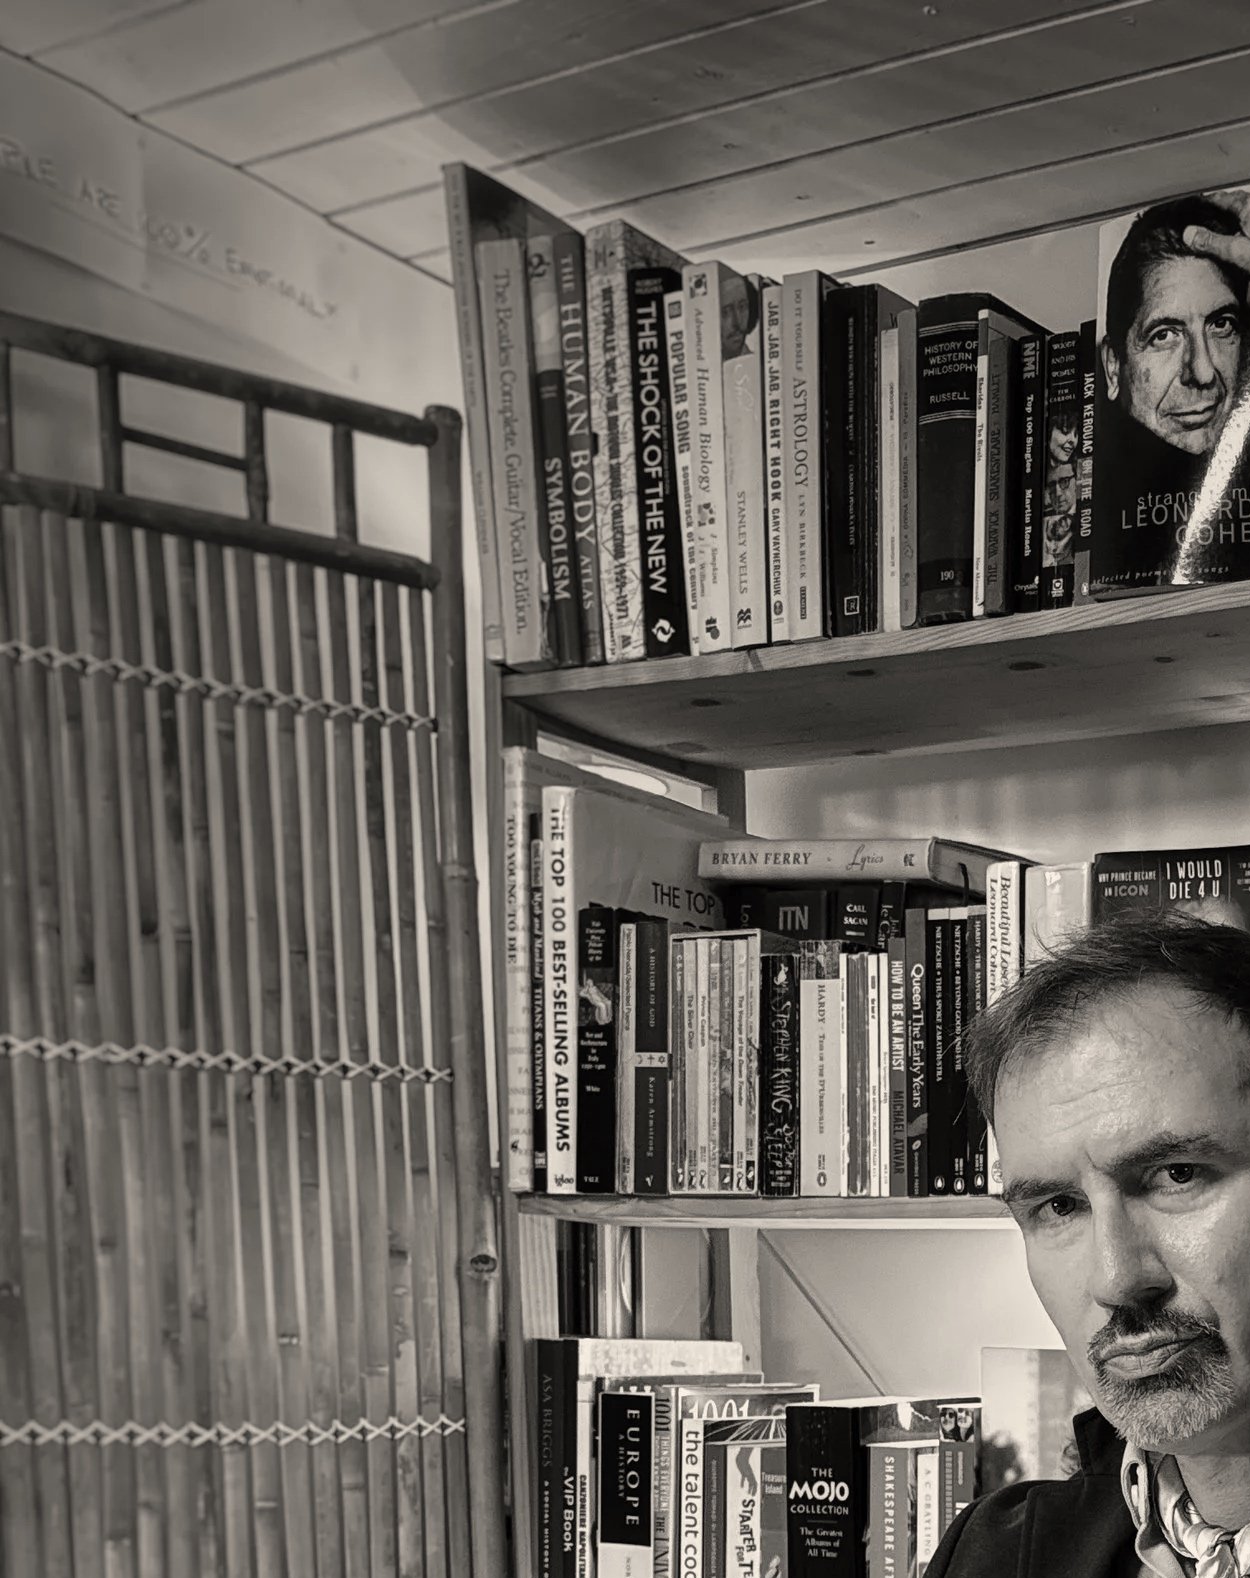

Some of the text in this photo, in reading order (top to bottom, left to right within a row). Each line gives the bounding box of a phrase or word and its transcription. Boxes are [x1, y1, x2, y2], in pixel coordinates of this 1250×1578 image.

[492, 269, 513, 305] The
[495, 306, 517, 367] Beatles
[924, 340, 979, 355] HISTORY OF
[922, 363, 979, 377] PHILOSOPHY
[928, 352, 972, 365] WESTERN
[1021, 342, 1036, 380] NME
[669, 331, 691, 455] POPULAR SONG
[930, 391, 970, 405] RUSSELL
[1083, 372, 1096, 398] JACK
[559, 254, 596, 609] THE HUMAN BODY ATLAS
[636, 301, 668, 594] THE SHOCK OF THE NEW
[696, 367, 714, 494] Human Biology
[793, 377, 809, 488] ASTROLOGY
[1081, 404, 1094, 454] KEROUAC
[504, 453, 527, 565] Guitar/Vocal
[769, 398, 782, 597] RIGHT HOOK GARY VAYNERCHUK
[543, 457, 571, 600] SYMBOLISM
[1080, 509, 1092, 537] ROAD
[736, 490, 749, 595] STANLEY WELLS
[712, 852, 812, 865] BRYAN FERRY
[1166, 860, 1222, 879] I WOULD
[652, 882, 717, 916] THE TOP
[1114, 885, 1149, 898] ICON
[1170, 879, 1220, 900] DIE 4 U
[779, 906, 808, 931] ITN
[549, 806, 572, 1152] THE TOP 100 BEST-SELLING ALBUMS
[890, 960, 905, 1174] HOW TO BE AN ARTIST MICHAEL ATAVAR
[908, 1040, 924, 1073] Early
[911, 1074, 924, 1108] Years
[541, 1374, 553, 1468] ASA BRIGGS
[685, 1431, 702, 1466] the
[624, 1409, 640, 1527] EUROPE
[812, 1467, 832, 1478] THE
[684, 1472, 701, 1538] talent
[789, 1480, 849, 1501] MOJO
[790, 1504, 849, 1515] COLLECTION
[884, 1455, 895, 1550] SHAKESPEARE
[562, 1476, 575, 1552] VIP Book
[739, 1499, 756, 1553] STARTER
